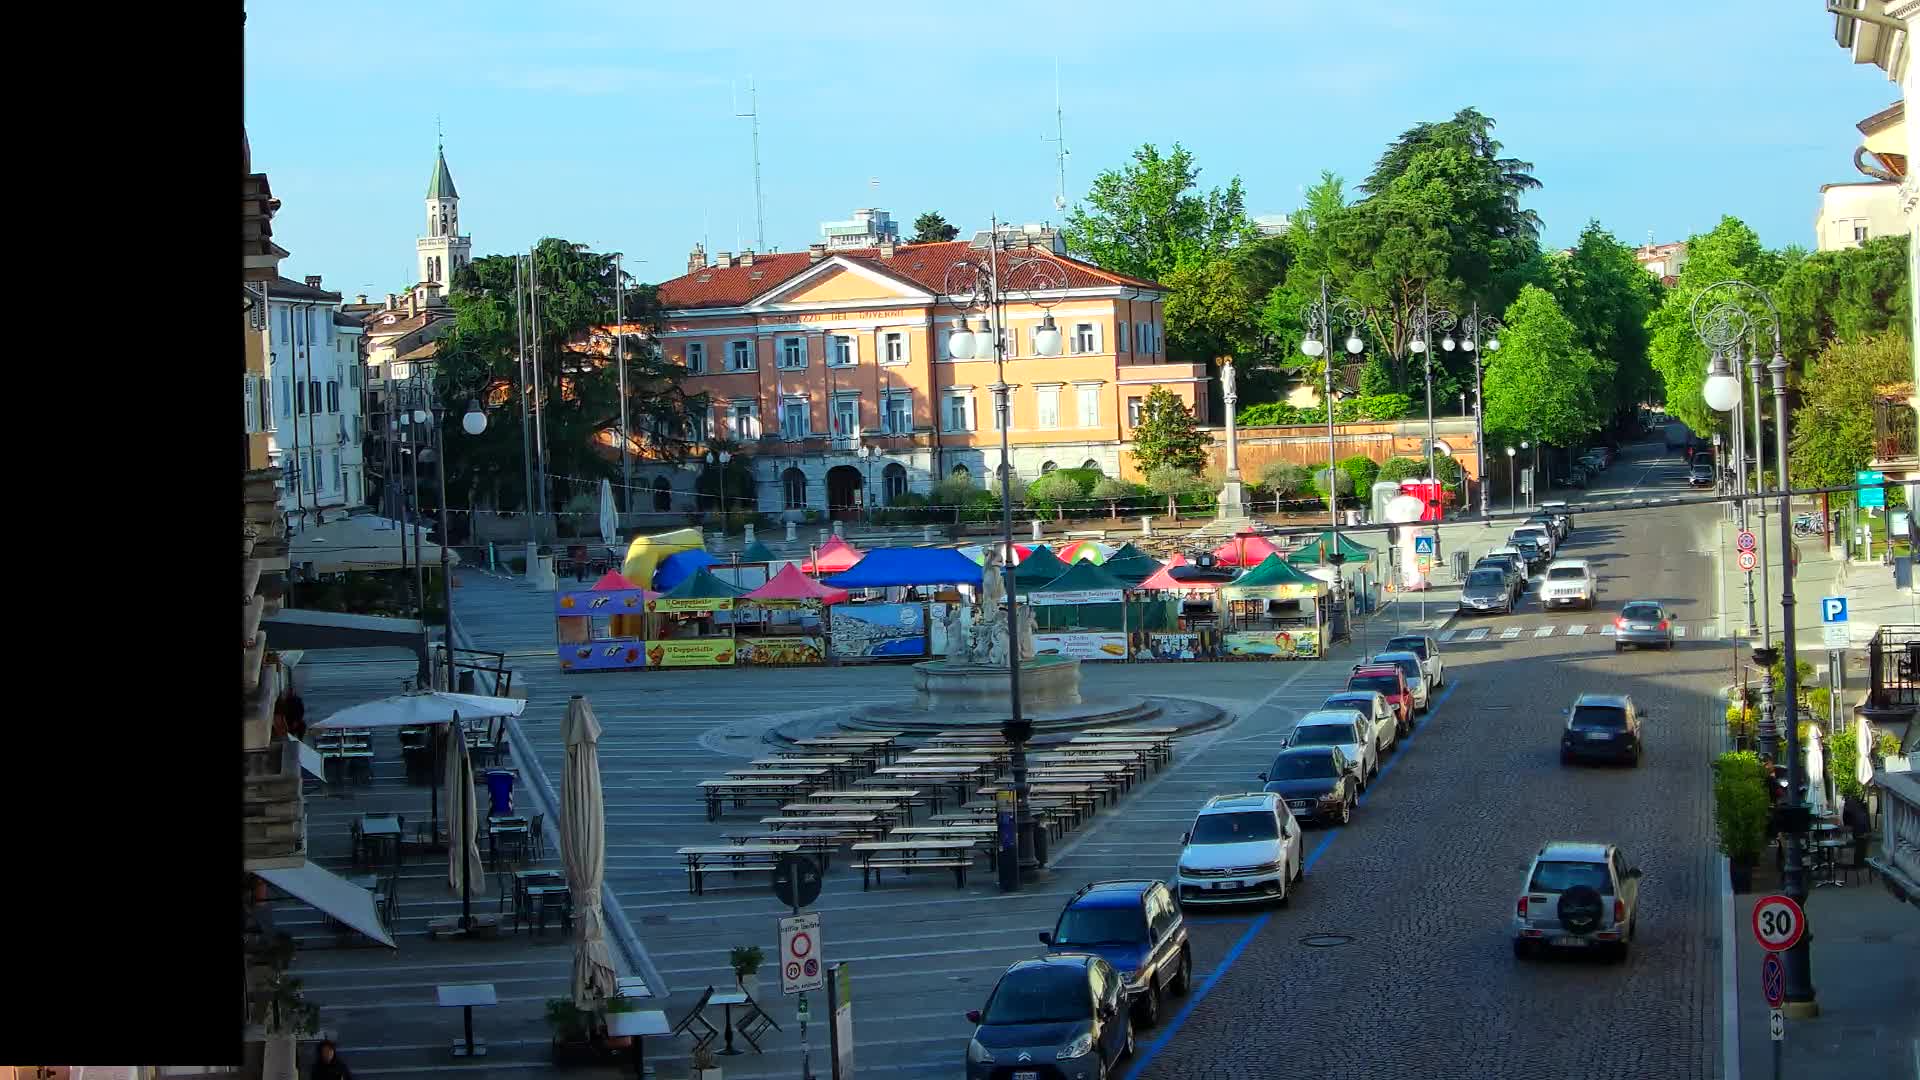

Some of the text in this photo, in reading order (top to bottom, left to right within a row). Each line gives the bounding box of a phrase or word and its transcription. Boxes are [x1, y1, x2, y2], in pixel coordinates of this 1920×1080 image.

[1742, 556, 1753, 565] 20
[1827, 599, 1842, 621] P
[1762, 910, 1791, 936] 30
